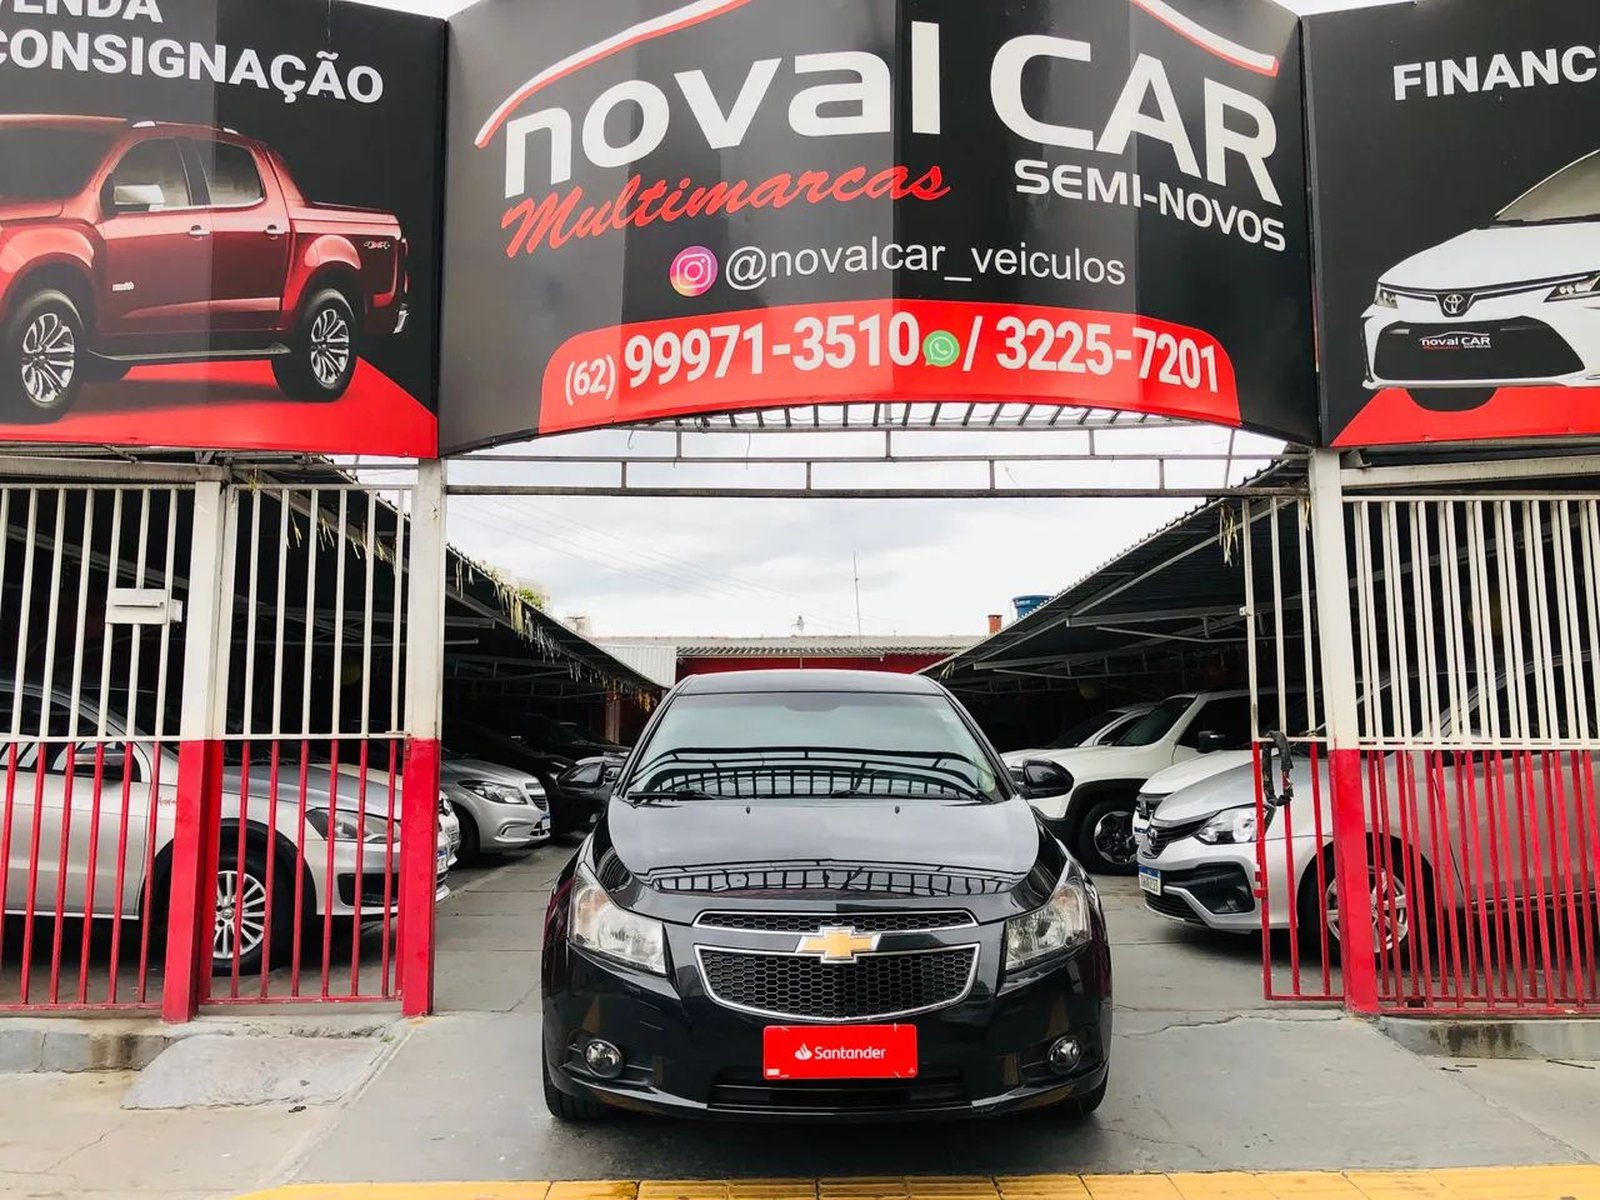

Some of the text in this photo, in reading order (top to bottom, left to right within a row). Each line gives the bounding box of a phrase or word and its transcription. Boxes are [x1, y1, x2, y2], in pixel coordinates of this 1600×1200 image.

[0, 28, 384, 104] ONSIGNAÇÃO
[1393, 45, 1600, 101] FINANC
[505, 21, 1282, 207] noval CAR
[501, 165, 951, 258] Multimarcas
[1015, 159, 1286, 252] SEMI-NOVOS
[725, 236, 1126, 291] @novalcar_veiculos
[564, 354, 616, 407] (62)
[624, 311, 920, 389] 99971-3510
[996, 316, 1218, 394] 3225-7201
[1461, 336, 1491, 346] CAR
[814, 1046, 887, 1060] Santander
